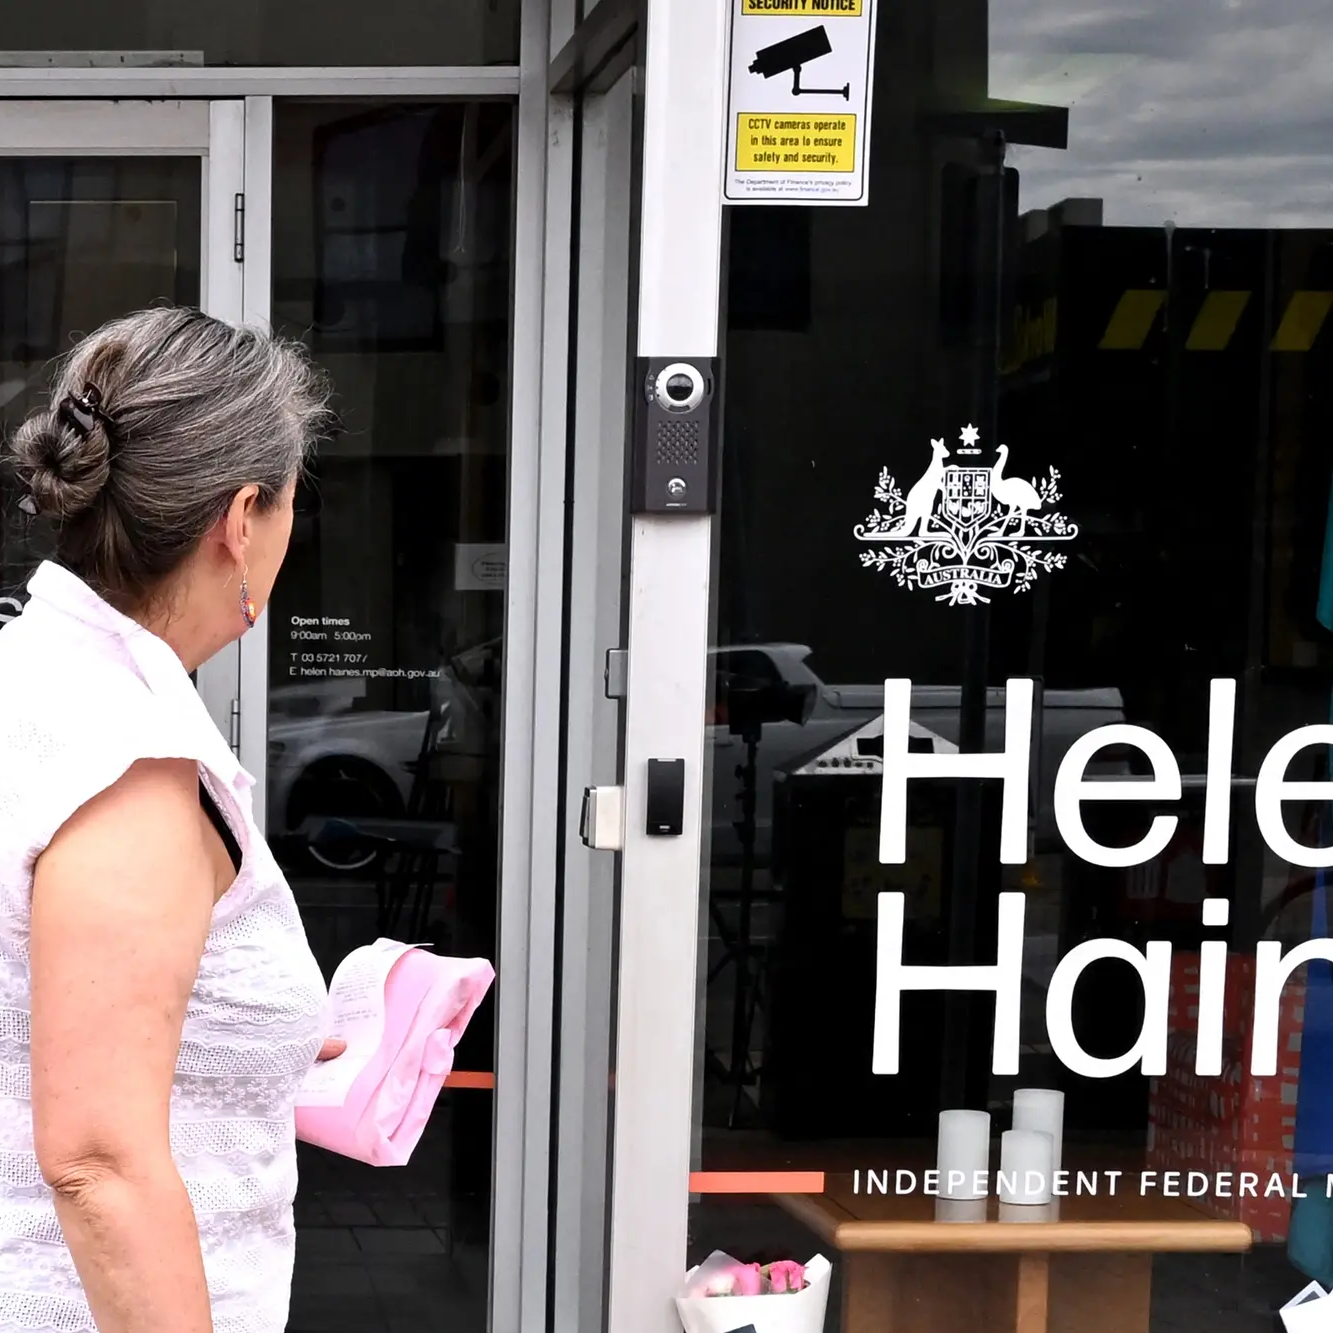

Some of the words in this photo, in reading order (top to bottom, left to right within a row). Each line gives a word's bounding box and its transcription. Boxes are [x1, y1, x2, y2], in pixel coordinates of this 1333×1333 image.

[748, 0, 807, 10] SECURITY
[812, 0, 855, 10] NOTICE
[748, 118, 772, 129] CCTV
[774, 120, 811, 130] cameras
[814, 120, 846, 132] operate
[750, 135, 759, 146] in
[761, 135, 777, 146] this
[779, 138, 799, 146] area
[803, 136, 811, 146] to
[813, 138, 843, 147] ensure
[753, 152, 781, 164] safety
[783, 152, 799, 162] and
[802, 152, 839, 165] security.
[924, 568, 1002, 585] AUSTRALIA
[291, 616, 319, 626] Open
[322, 616, 350, 626] times
[290, 652, 298, 662] T
[301, 653, 314, 662] 03
[316, 653, 340, 662] 5721
[289, 666, 297, 676] E
[879, 678, 1333, 868] Hele
[872, 891, 1333, 1079] Hain
[852, 1169, 1123, 1197] INDEPENDENT
[1140, 1170, 1308, 1198] FEDERAL
